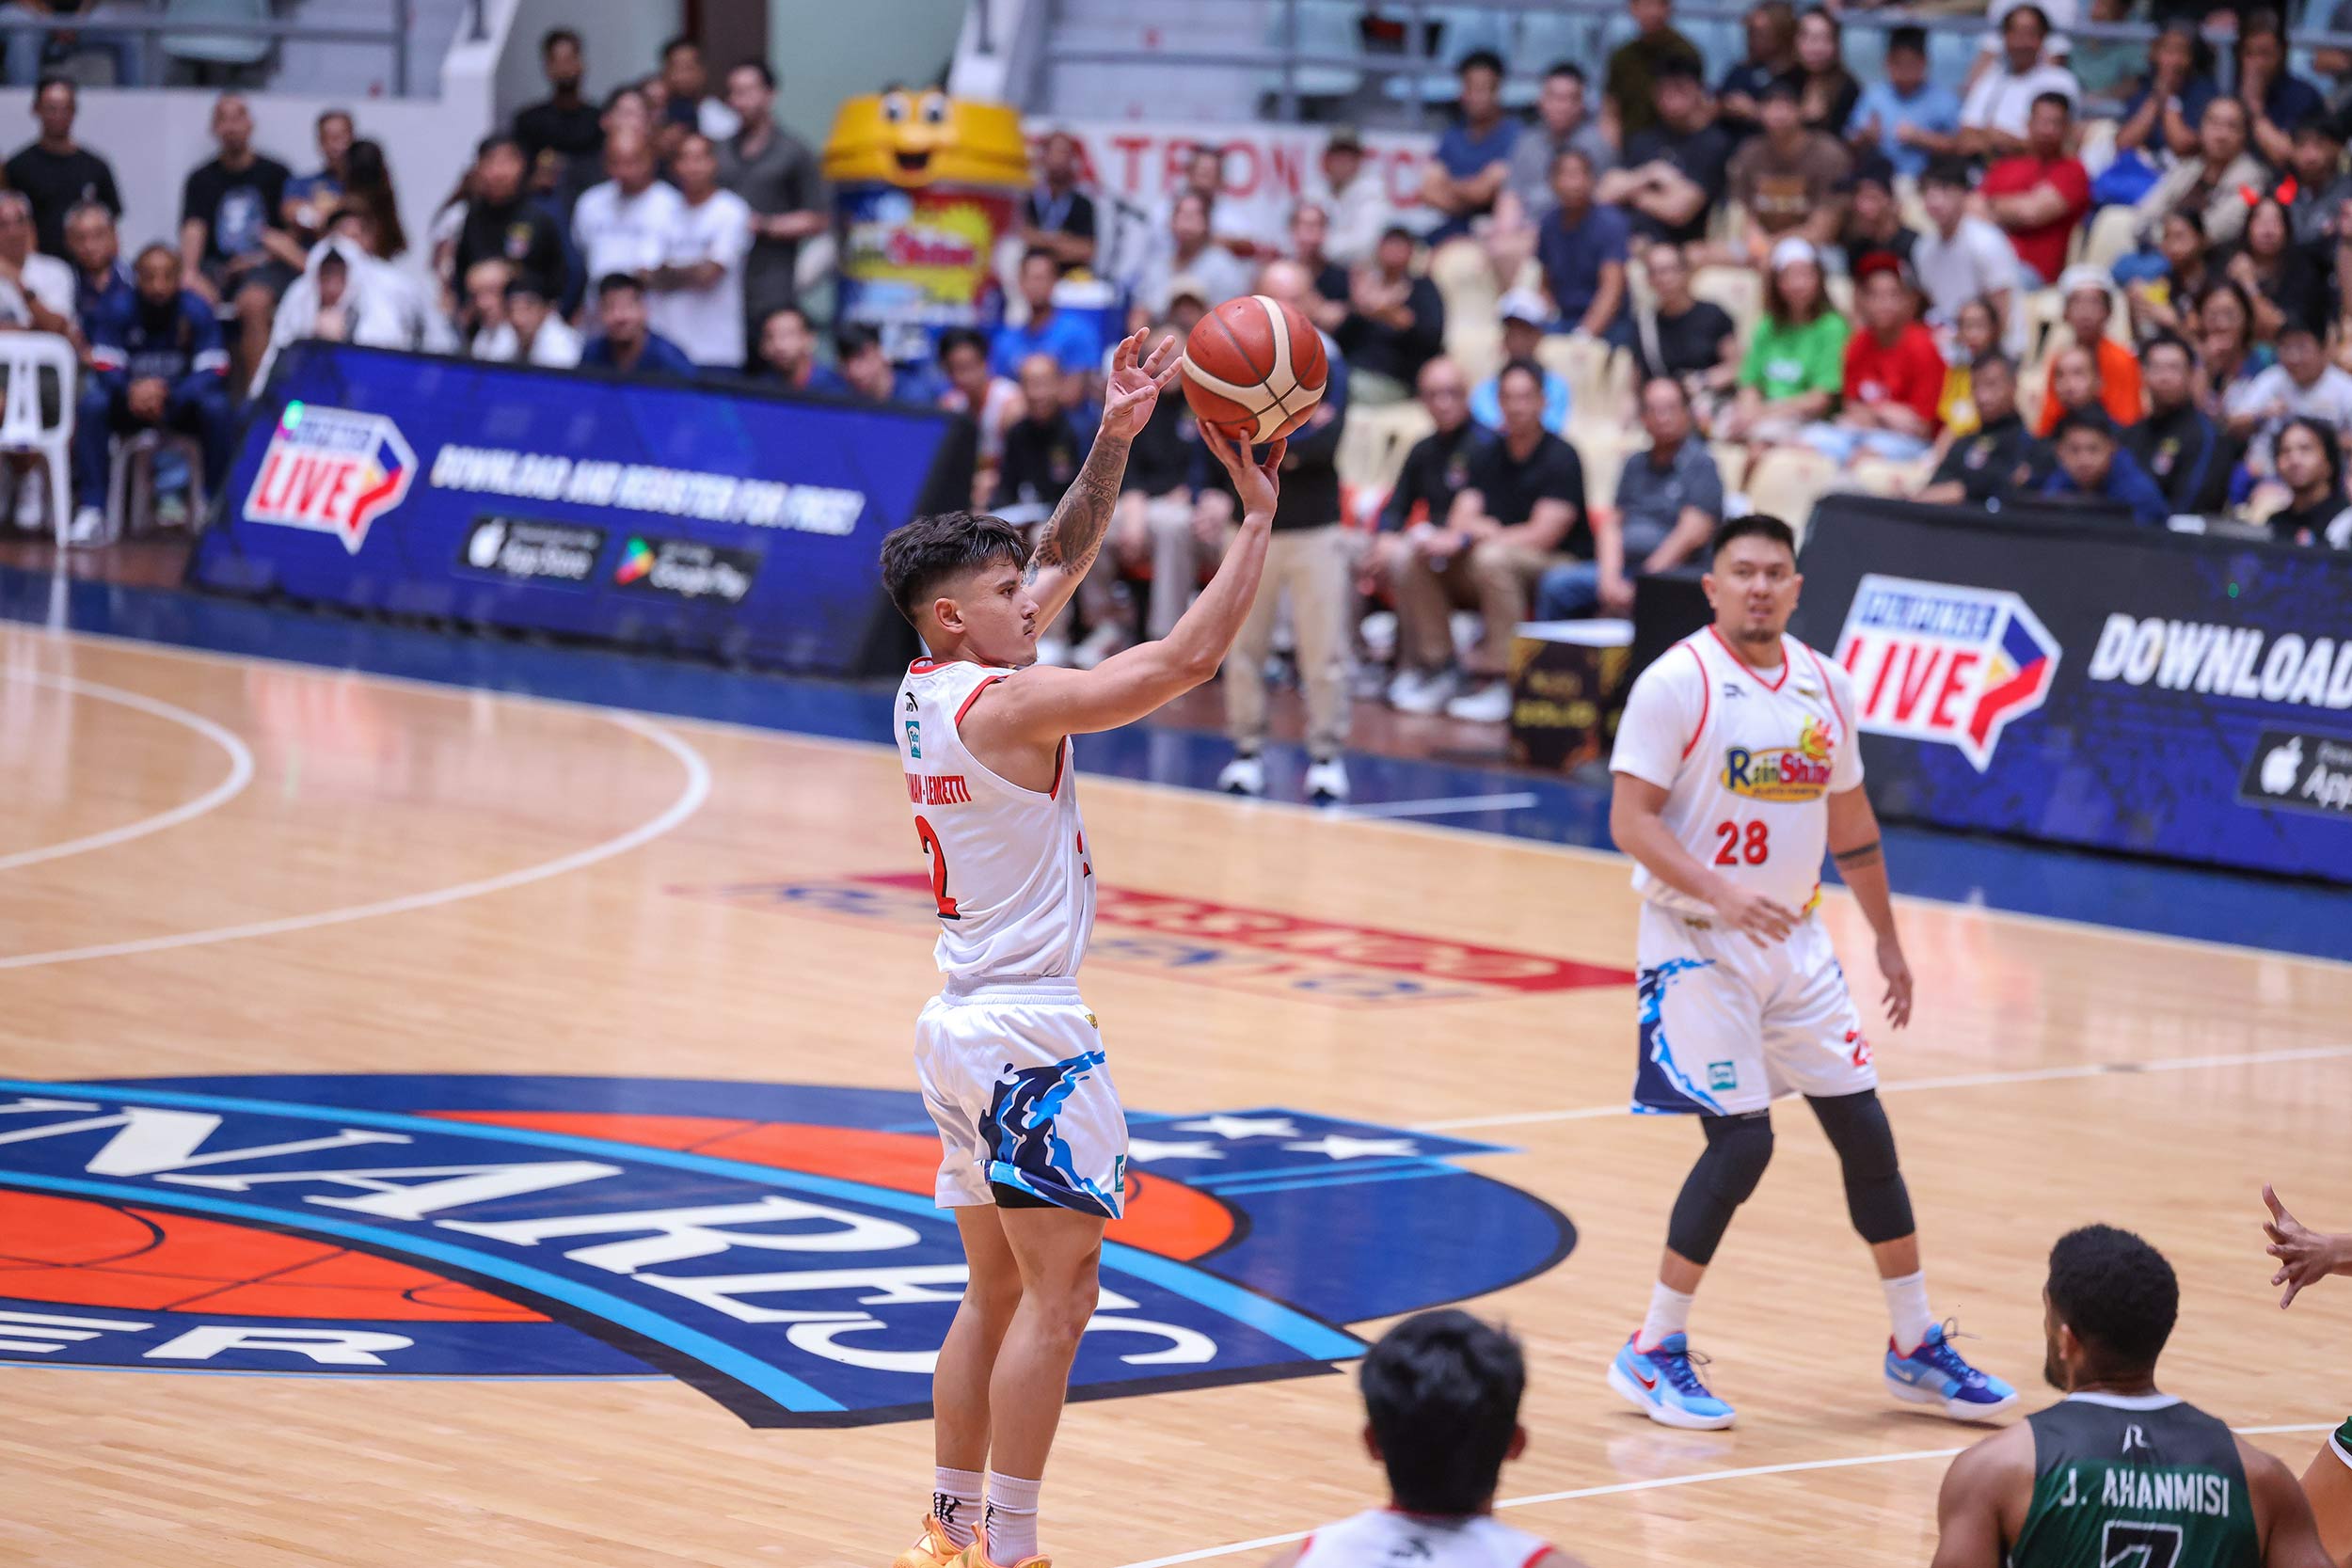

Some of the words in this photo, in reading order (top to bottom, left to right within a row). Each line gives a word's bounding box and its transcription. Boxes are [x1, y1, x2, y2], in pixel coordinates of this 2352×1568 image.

[257, 455, 358, 518] LIVE
[1715, 820, 1769, 865] 28
[2059, 1467, 2088, 1507] J.
[2101, 1467, 2230, 1517] AHANMISI
